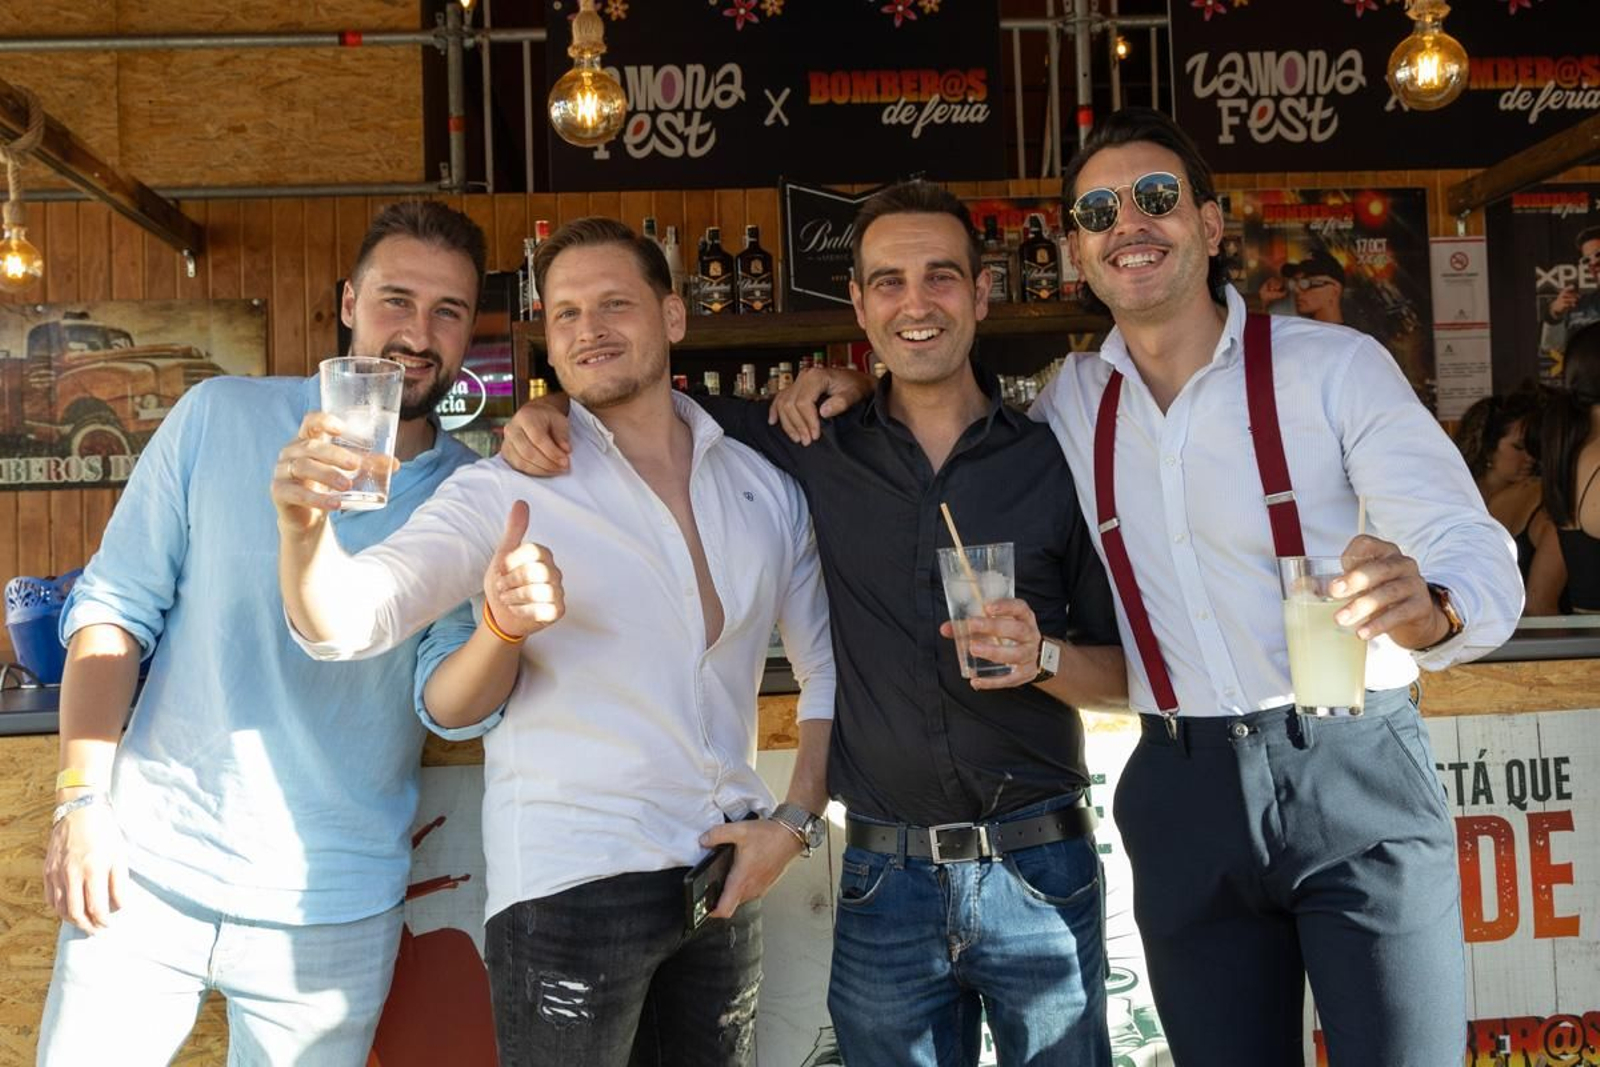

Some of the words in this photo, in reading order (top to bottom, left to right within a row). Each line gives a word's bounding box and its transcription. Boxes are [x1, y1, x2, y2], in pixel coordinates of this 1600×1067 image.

[808, 68, 988, 105] BOMBER@S
[1468, 55, 1600, 90] MBER@S
[764, 88, 790, 126] X
[1499, 84, 1536, 111] de
[881, 97, 917, 125] de
[913, 96, 990, 139] feria
[1217, 97, 1339, 145] Fest
[109, 455, 139, 481] D
[1436, 749, 1494, 806] TÁ
[1505, 756, 1572, 811] QUE
[1455, 810, 1580, 943] DE
